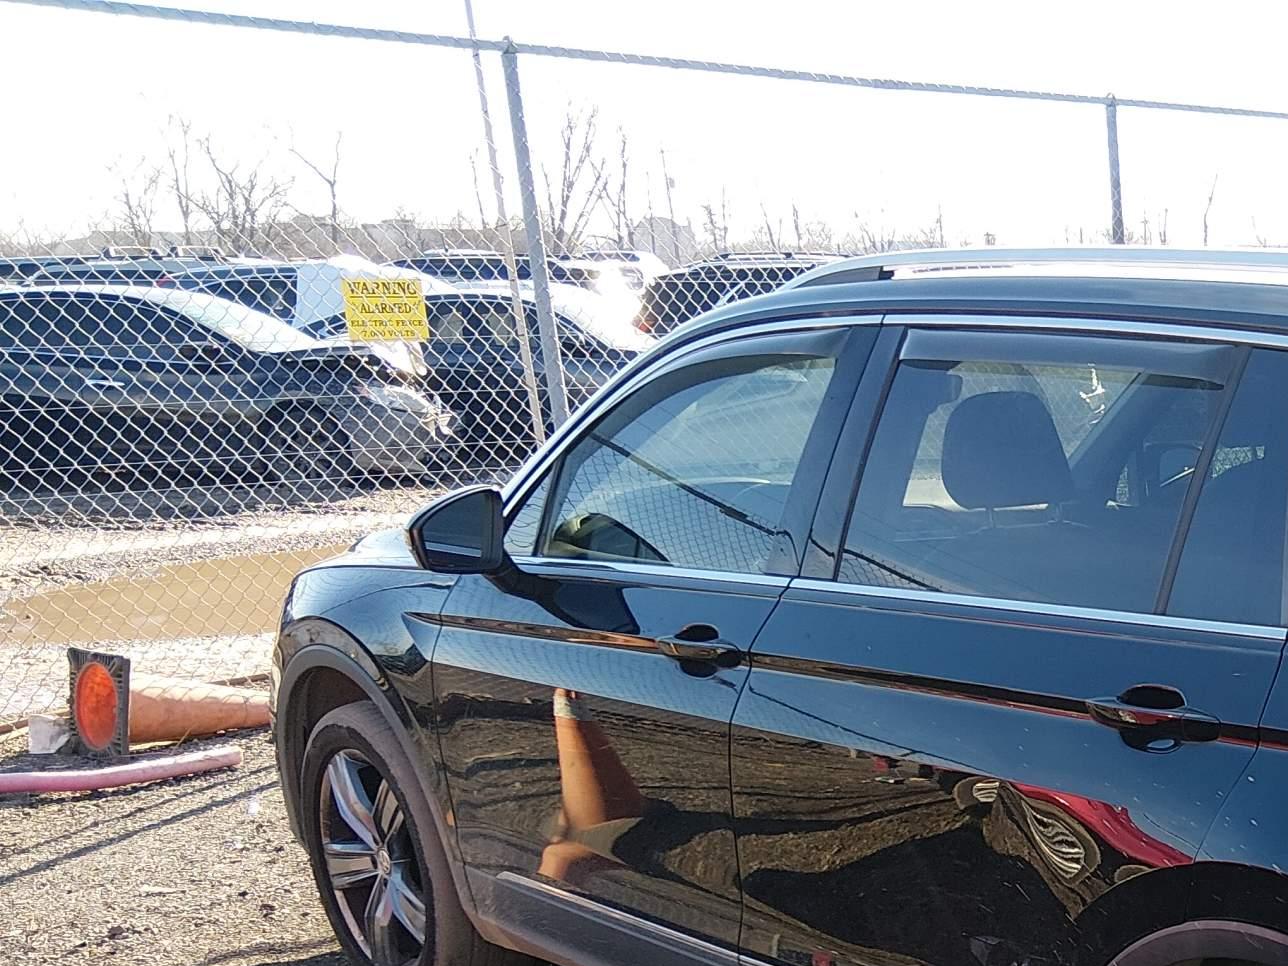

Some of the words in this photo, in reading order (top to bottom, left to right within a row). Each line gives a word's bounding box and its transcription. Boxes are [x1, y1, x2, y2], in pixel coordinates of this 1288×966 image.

[348, 281, 417, 295] WARNING
[351, 319, 394, 327] ELECTRIC
[396, 319, 424, 327] FENCE
